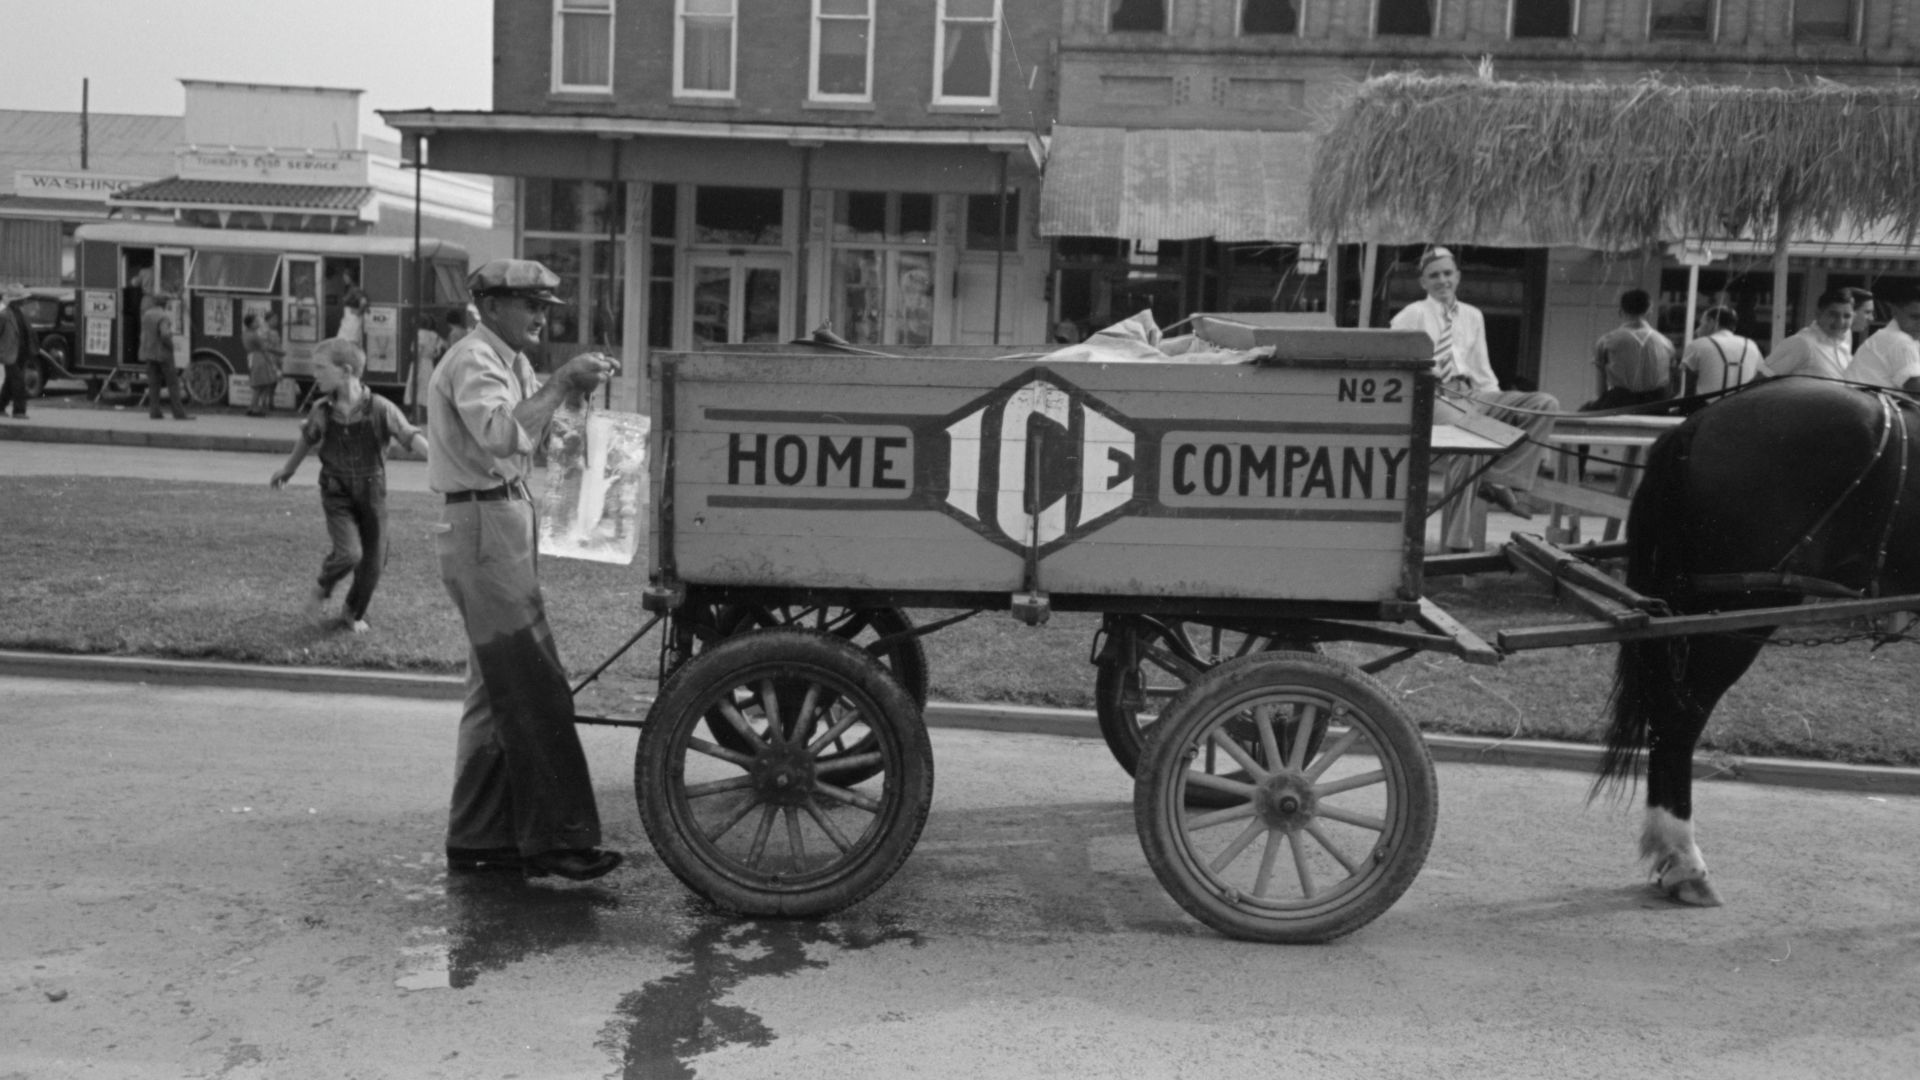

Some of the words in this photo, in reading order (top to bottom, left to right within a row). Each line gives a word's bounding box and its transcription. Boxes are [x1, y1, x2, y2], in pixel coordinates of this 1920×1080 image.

[287, 159, 338, 171] SERVICE
[1382, 377, 1403, 403] 2
[727, 432, 908, 490] HOME
[945, 379, 1136, 548] ICE
[1172, 443, 1410, 500] COMPANY
